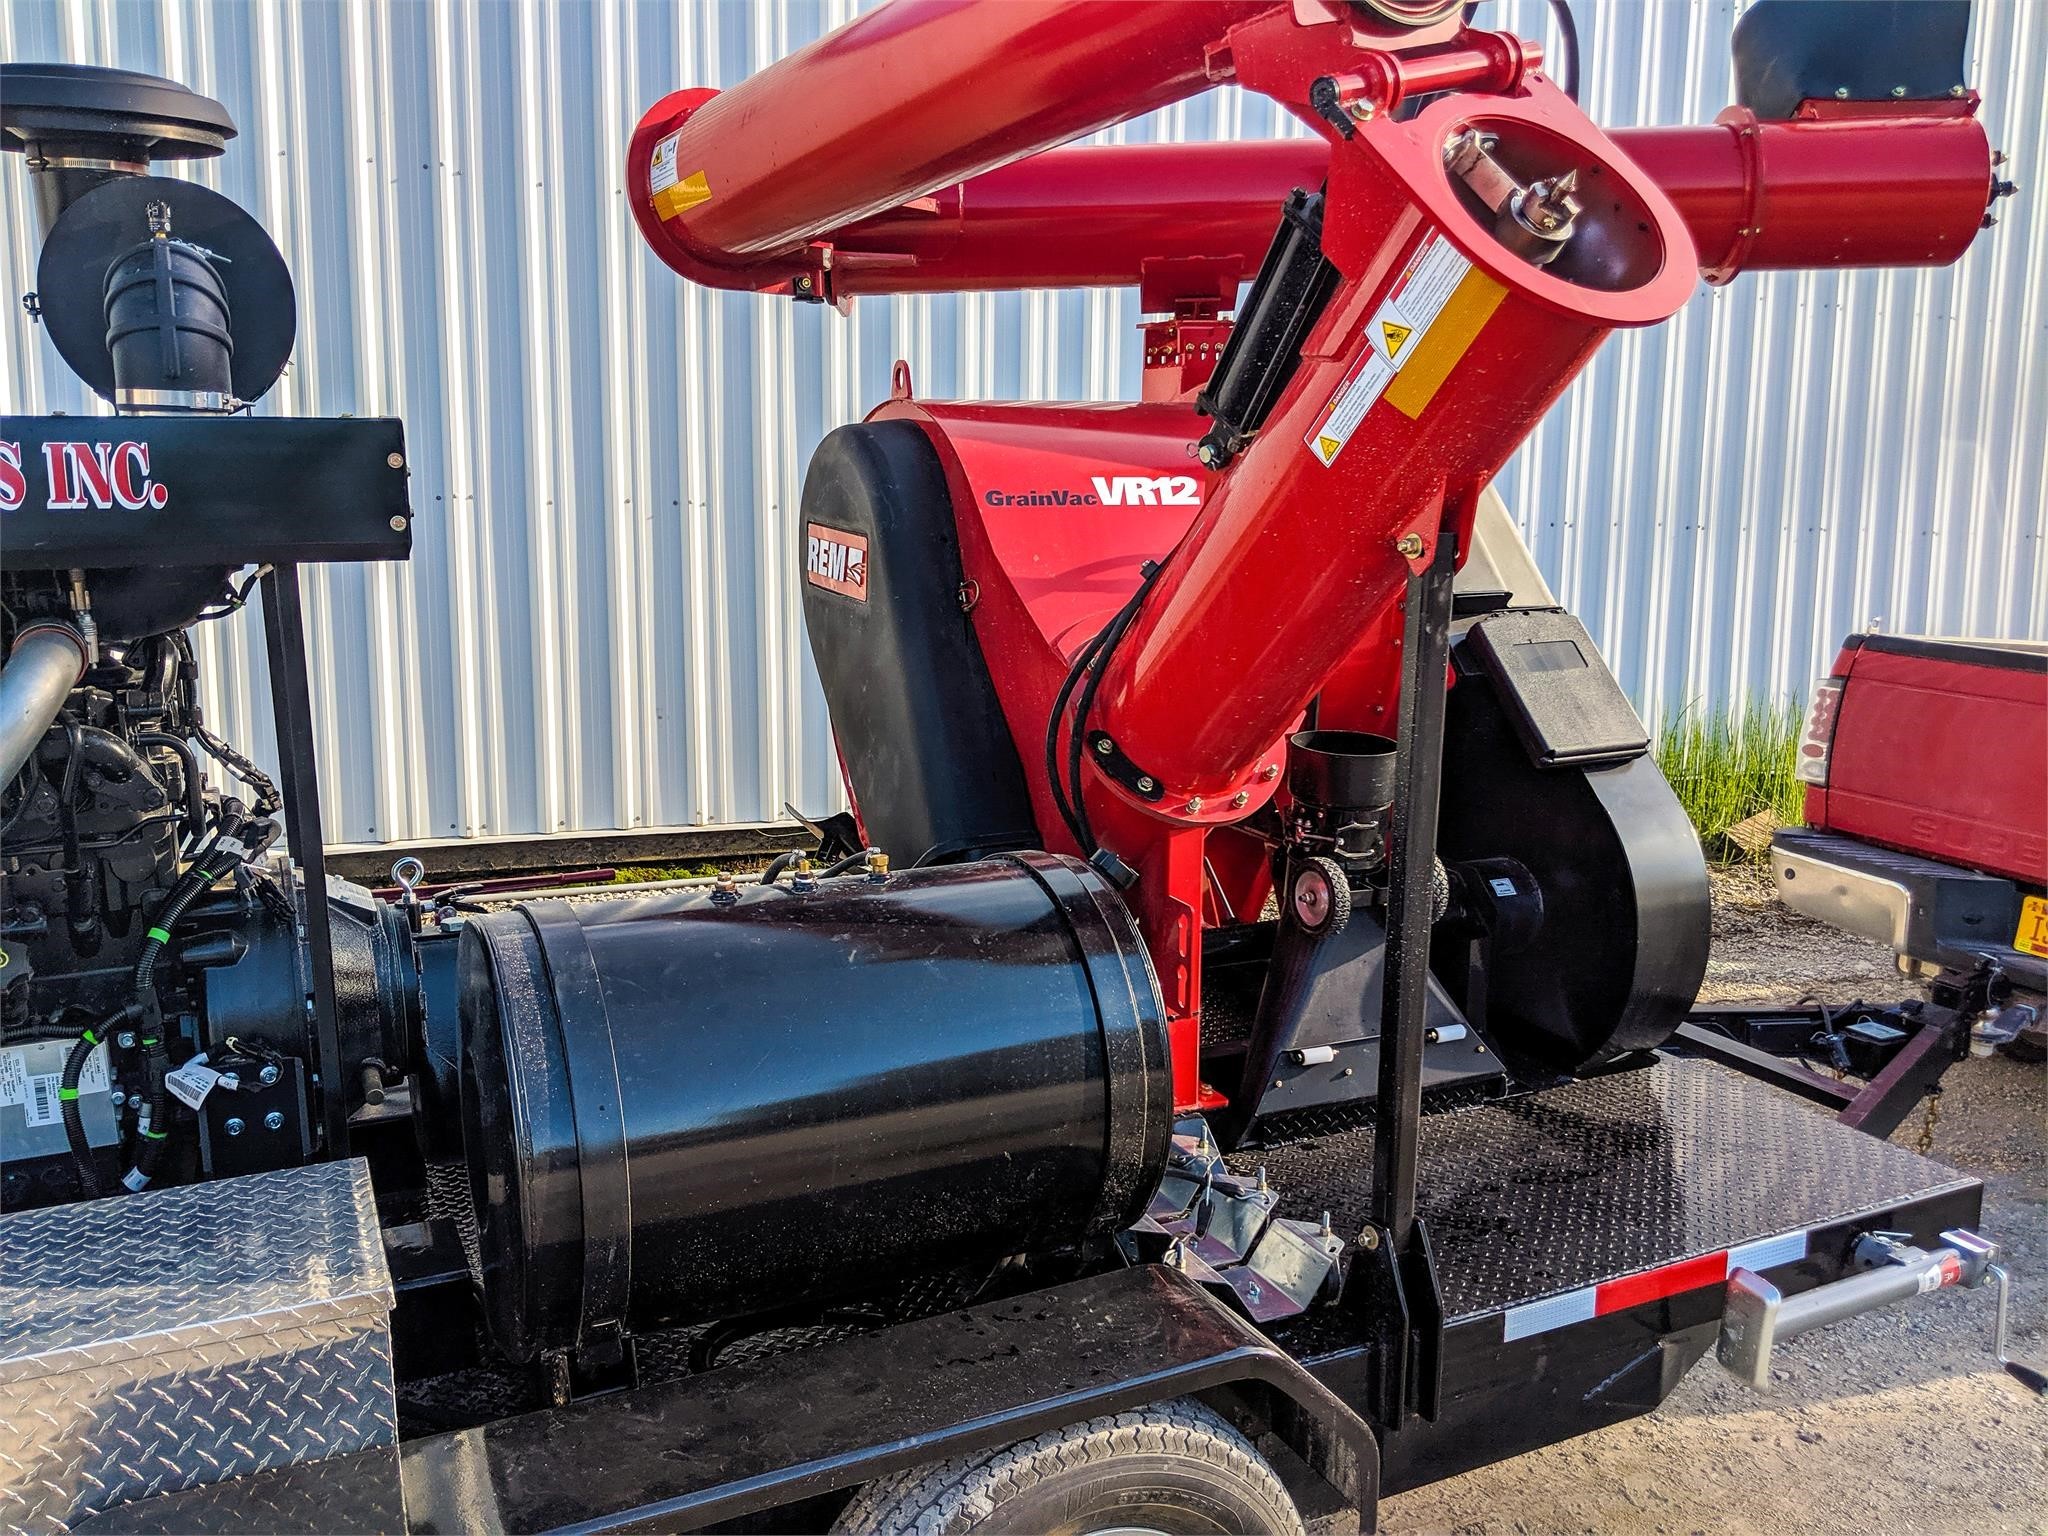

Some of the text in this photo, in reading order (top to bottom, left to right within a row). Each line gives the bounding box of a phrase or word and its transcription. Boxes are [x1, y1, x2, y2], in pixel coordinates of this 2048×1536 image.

[1410, 243, 1430, 271] DANGER
[1332, 380, 1351, 404] DANGER
[42, 441, 168, 510] INC.
[985, 475, 1201, 507] GrainVac VR12
[808, 536, 847, 582] REM
